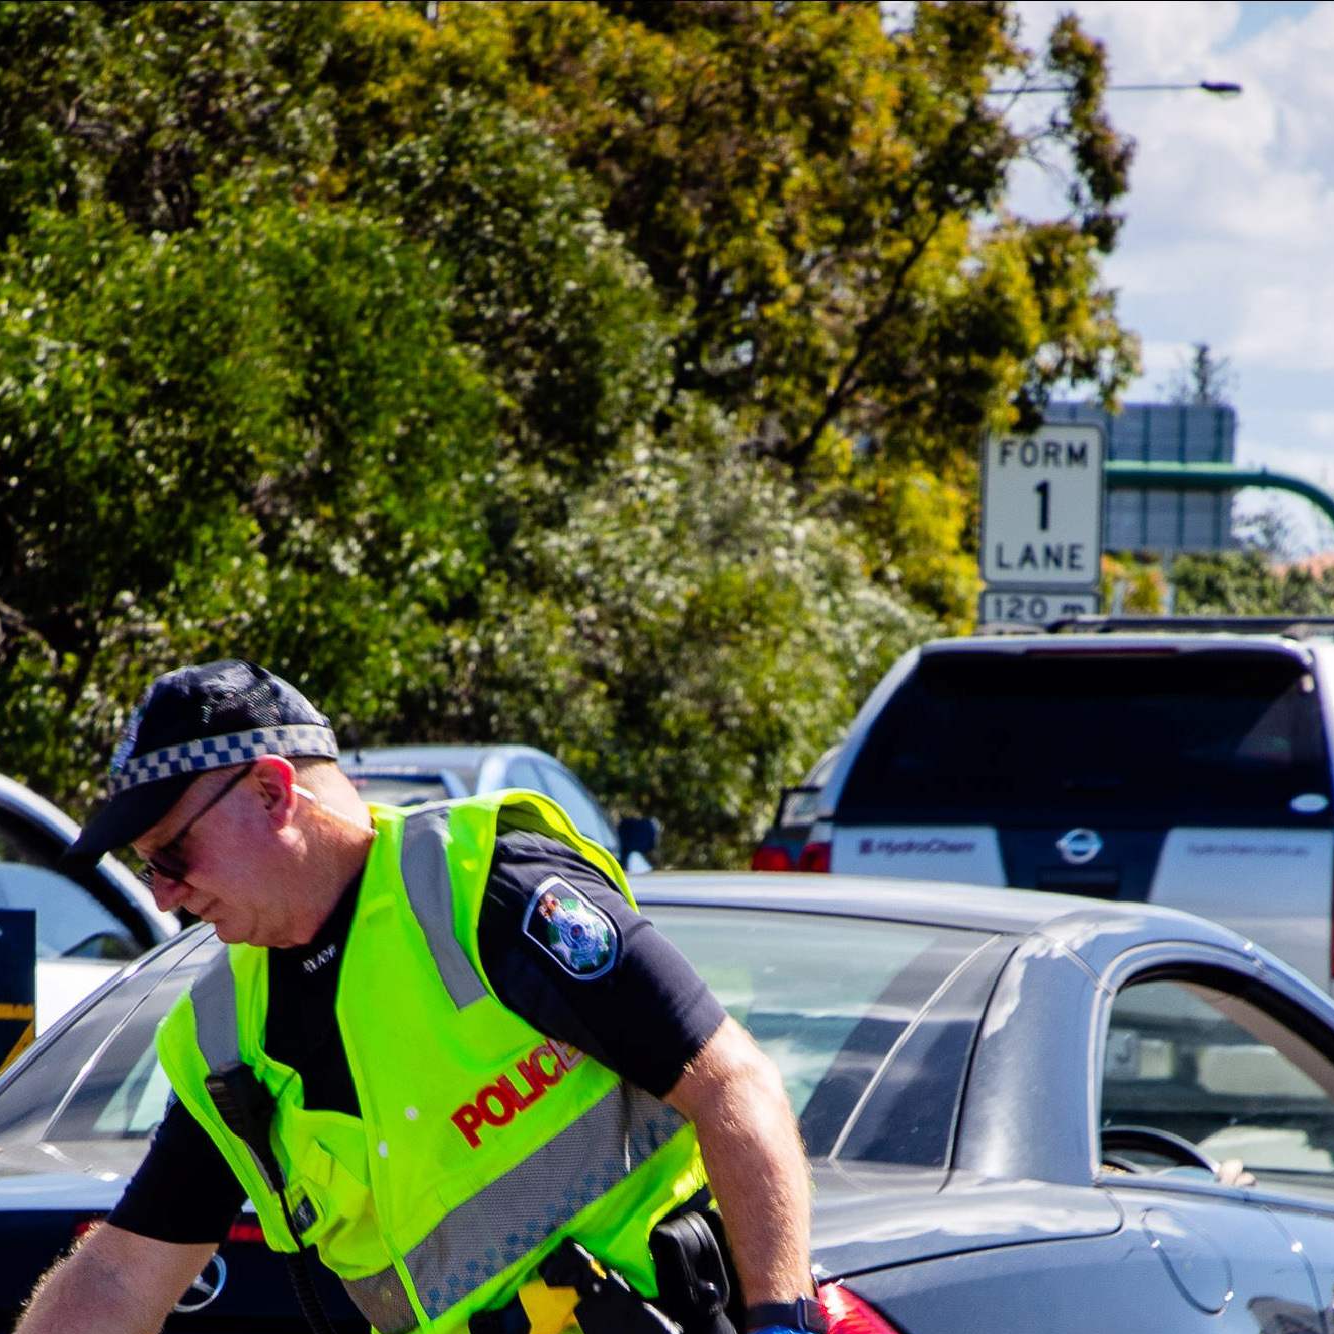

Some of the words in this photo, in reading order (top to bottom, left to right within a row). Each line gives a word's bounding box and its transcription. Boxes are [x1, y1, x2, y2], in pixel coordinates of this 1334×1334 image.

[999, 441, 1089, 468] FORM
[1034, 480, 1051, 532] 1
[995, 543, 1085, 571] LANE
[994, 597, 1048, 620] 120
[450, 1037, 584, 1149] POLICE
